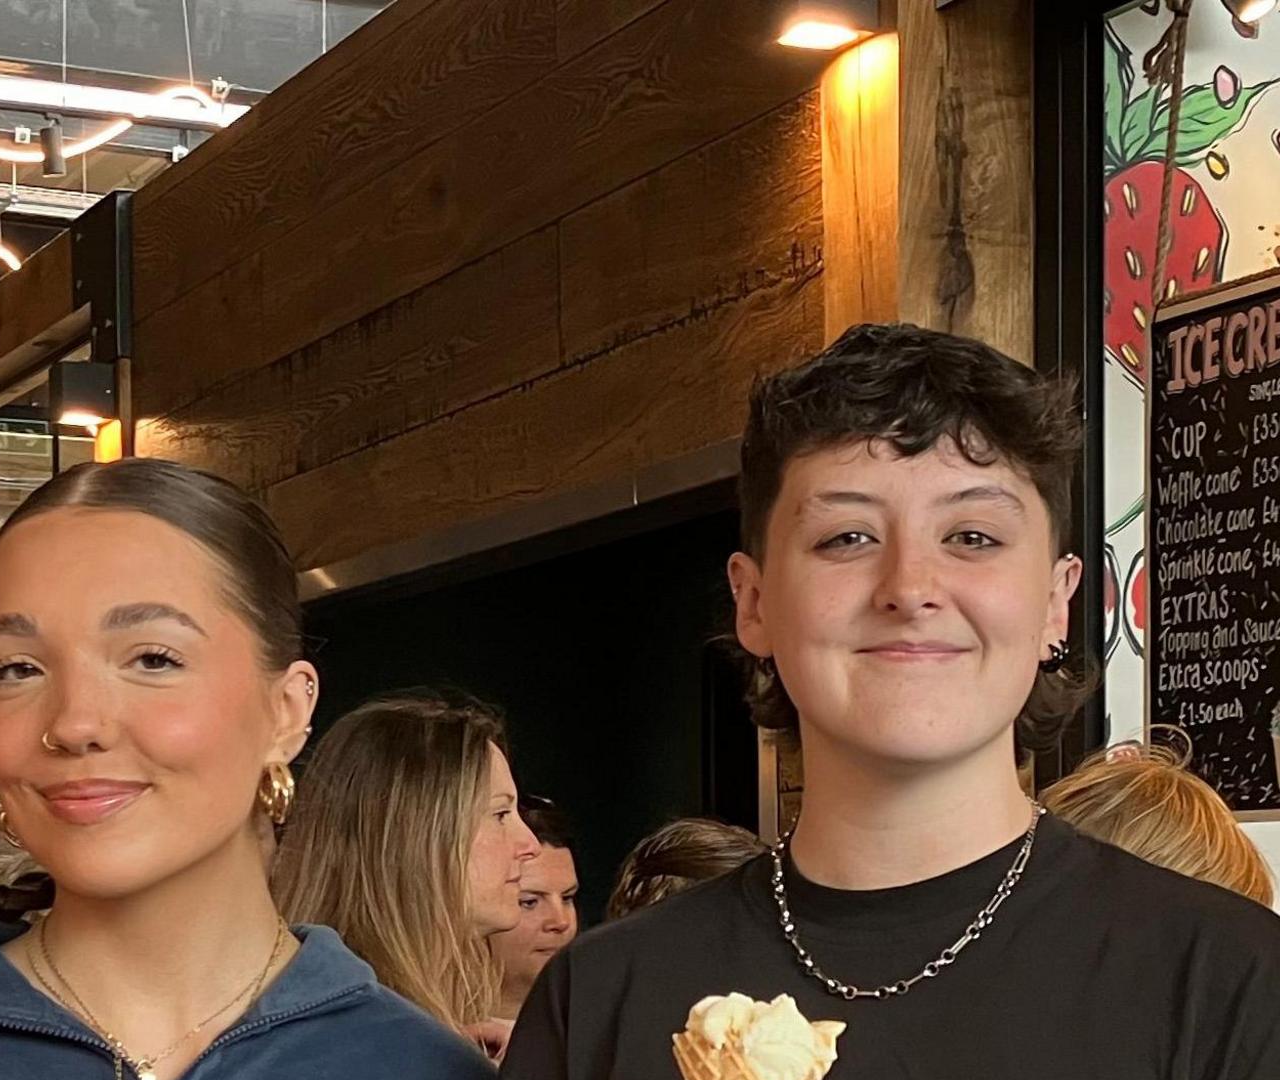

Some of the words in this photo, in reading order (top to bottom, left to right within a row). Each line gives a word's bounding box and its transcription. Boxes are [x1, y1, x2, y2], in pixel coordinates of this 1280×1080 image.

[1166, 316, 1222, 395] ICE
[1171, 421, 1207, 460] CUP
[1157, 470, 1203, 510] Waffle
[1205, 467, 1242, 497] cone
[1156, 508, 1224, 546] Chocolate
[1226, 507, 1256, 533] cone
[1158, 547, 1216, 591] Sprinkle
[1160, 588, 1237, 627] EXTRAS:
[1158, 626, 1210, 661] Topping
[1211, 620, 1238, 649] and
[1158, 662, 1201, 692] Extra
[1215, 697, 1244, 721] each
